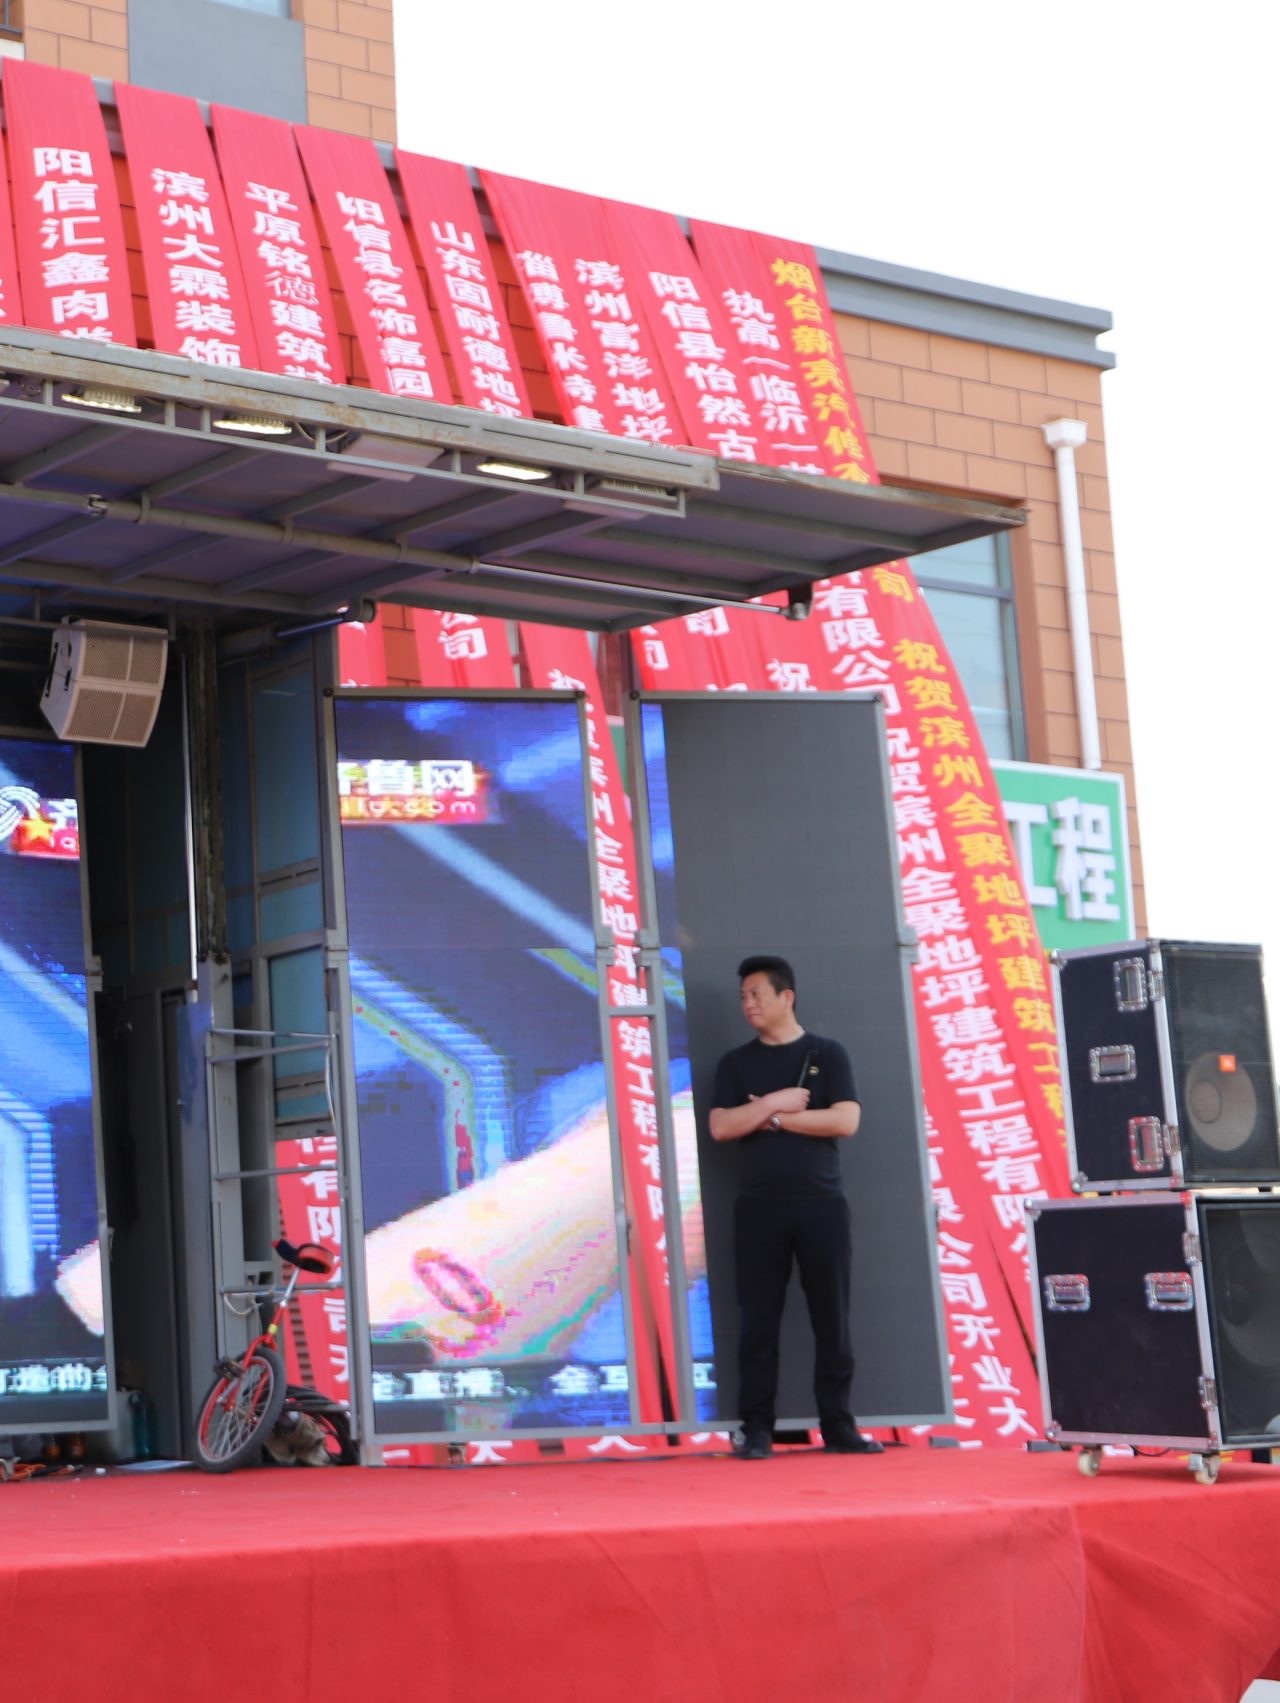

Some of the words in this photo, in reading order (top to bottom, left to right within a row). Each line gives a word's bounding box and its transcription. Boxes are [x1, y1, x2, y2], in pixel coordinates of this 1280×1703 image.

[648, 271, 758, 462] 阳信县怡然古
[1002, 795, 1120, 921] 工程
